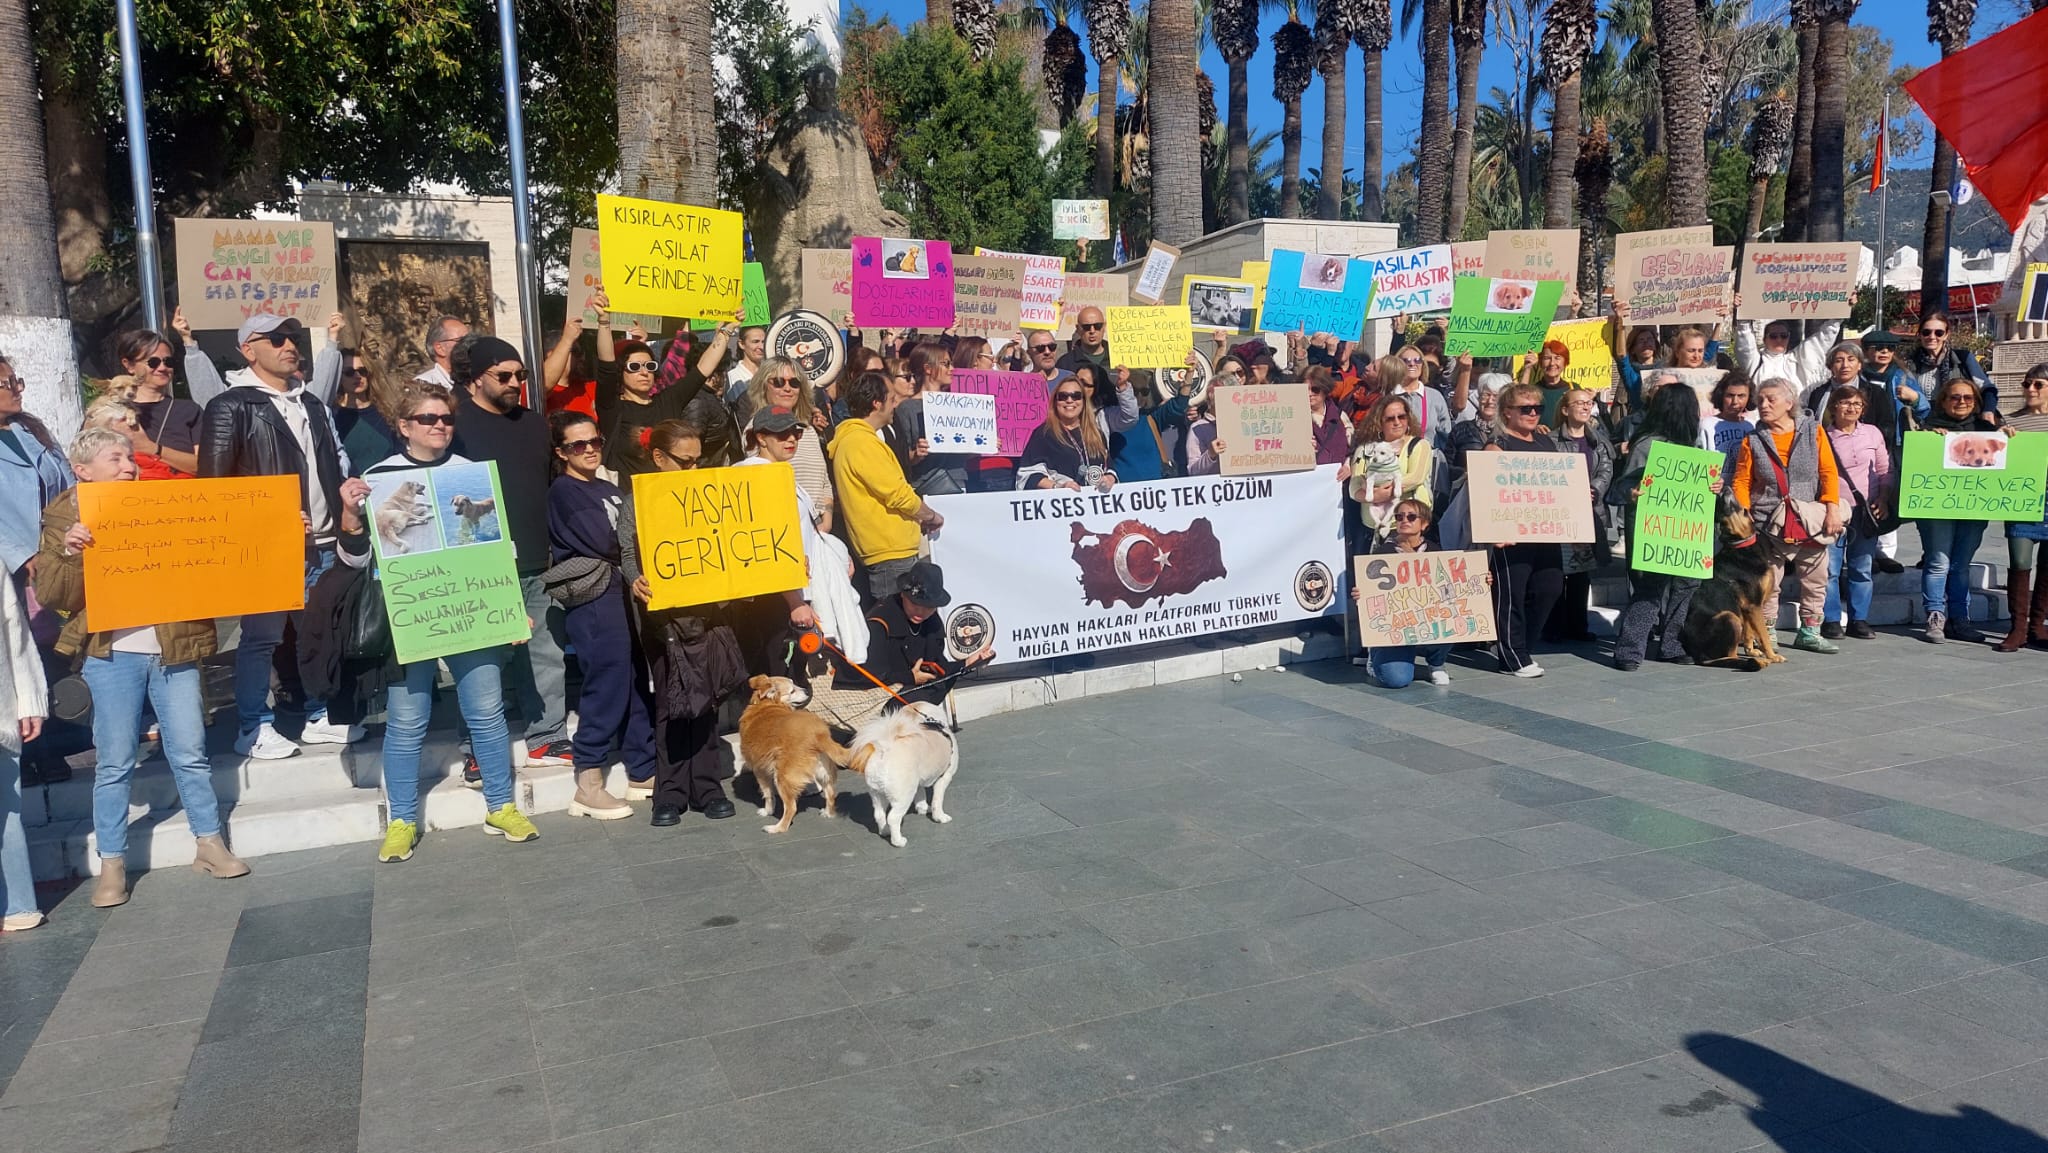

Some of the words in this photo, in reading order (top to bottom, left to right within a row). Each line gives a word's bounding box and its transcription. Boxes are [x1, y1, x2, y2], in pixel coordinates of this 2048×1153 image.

[613, 206, 712, 235] KISIRLAŞTIR
[277, 228, 314, 249] VER
[649, 239, 710, 264] AŞILAT
[274, 247, 316, 265] VER
[1374, 250, 1433, 276] AŞILAT
[203, 261, 252, 282] CAN
[624, 264, 698, 292] YERİNDE
[702, 273, 741, 298] YAŞAT
[1023, 275, 1065, 289] ESARET
[1020, 308, 1056, 321] MEYİN
[1652, 456, 1710, 486] SUSMA
[1910, 473, 1988, 490] DESTEK
[1998, 476, 2037, 493] VER
[671, 480, 754, 528] YASAYI
[1010, 500, 1046, 522] TEK
[1051, 497, 1086, 519] SES
[1088, 492, 1126, 515] TEK
[1130, 487, 1167, 512] GÜÇ
[1171, 485, 1206, 507] TEK
[1211, 478, 1273, 507] ÇÖZÜM
[1647, 486, 1705, 514] HAYKIR
[1907, 494, 1935, 509] BİZ
[653, 528, 726, 580] GERİ
[729, 524, 799, 569] ÇEK
[1642, 543, 1704, 570] DURDUR
[387, 561, 452, 588] SUSMA,
[1366, 556, 1468, 591] SOKAK
[391, 582, 461, 605] SESSİZ
[465, 575, 514, 593] KALMA
[392, 597, 489, 627] CANLARIMIZA
[1012, 622, 1070, 642] HAYVAN
[1077, 612, 1138, 633] HAKLARI
[1145, 600, 1221, 624] PLATFORMU
[1228, 592, 1282, 610] TÜRKİYE
[1018, 640, 1070, 659] MUĞLA
[1077, 630, 1132, 650] HAYVAN
[1138, 622, 1197, 641] HAKLARI
[1204, 609, 1279, 631] PLATFORMU
